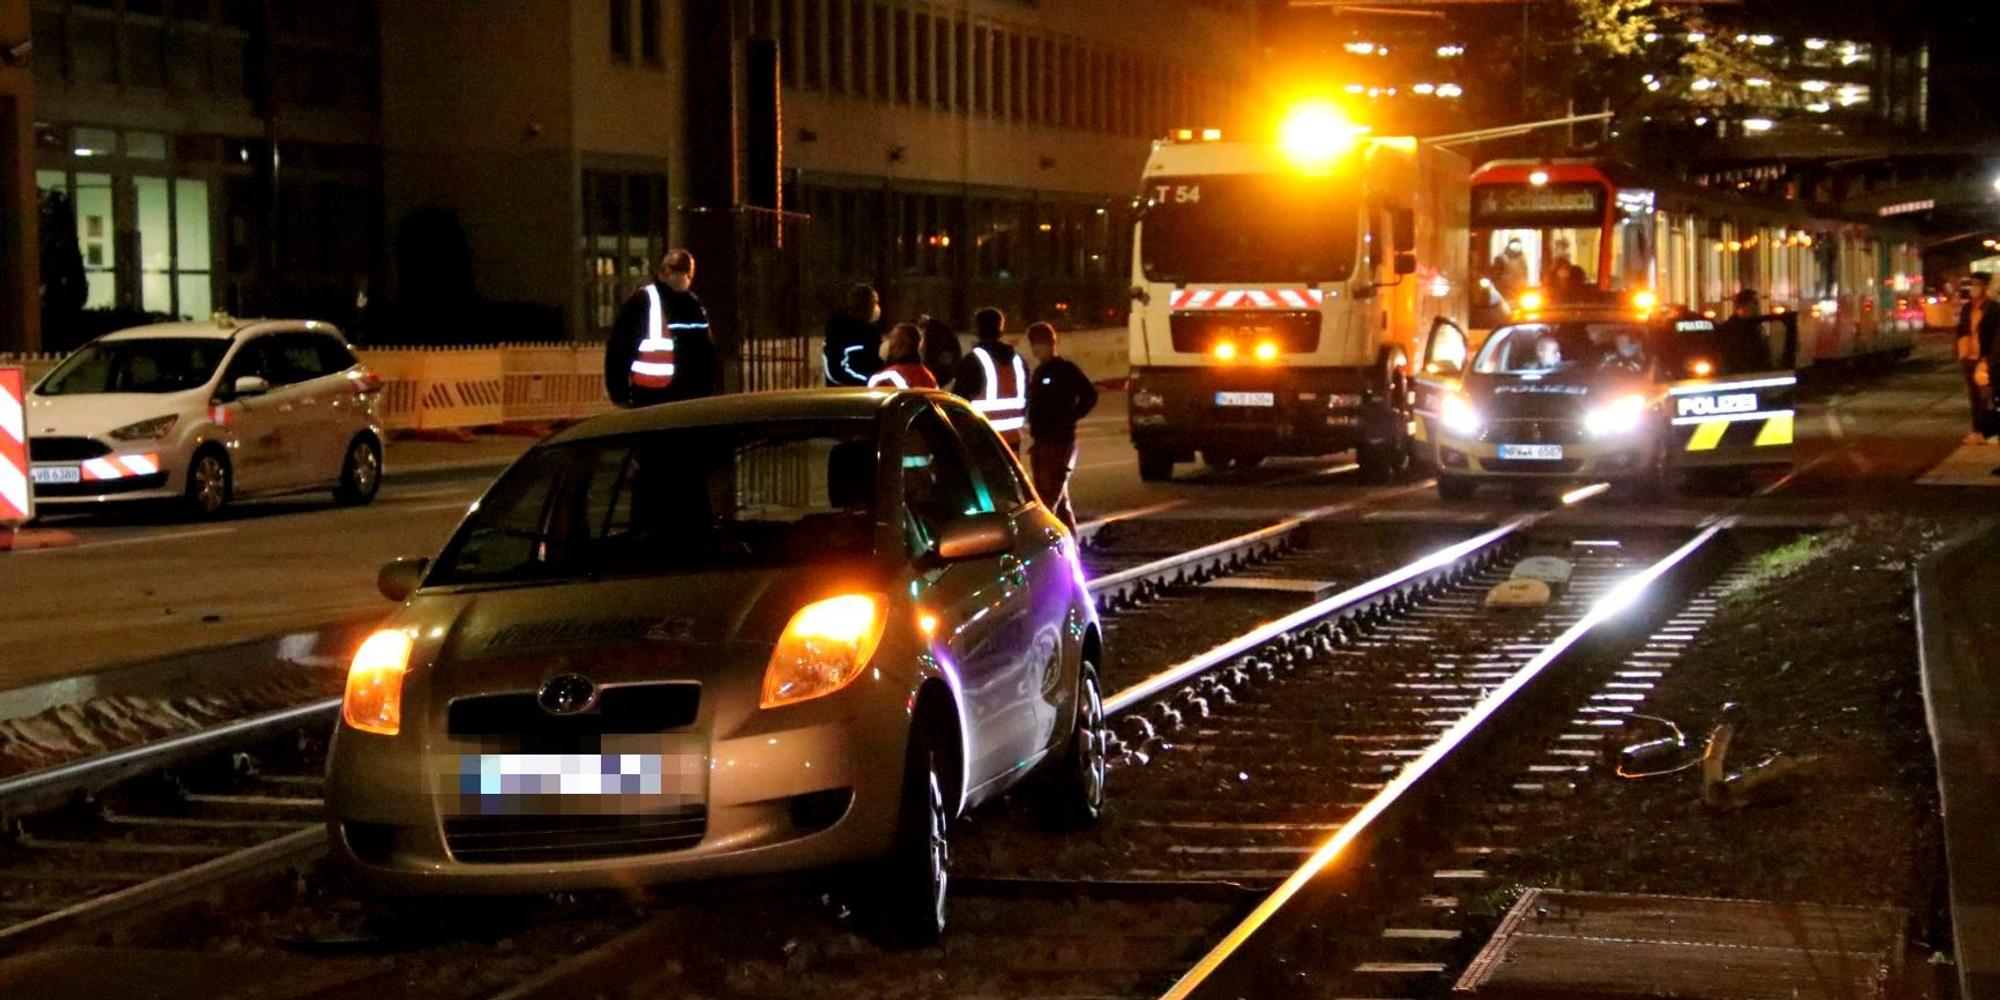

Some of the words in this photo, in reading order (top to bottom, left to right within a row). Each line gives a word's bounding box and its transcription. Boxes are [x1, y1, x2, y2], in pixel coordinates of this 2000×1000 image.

[1156, 185, 1170, 203] T
[1175, 185, 1200, 203] 54
[1494, 384, 1589, 395] POLIZEI
[1677, 393, 1757, 415] POLIZEI
